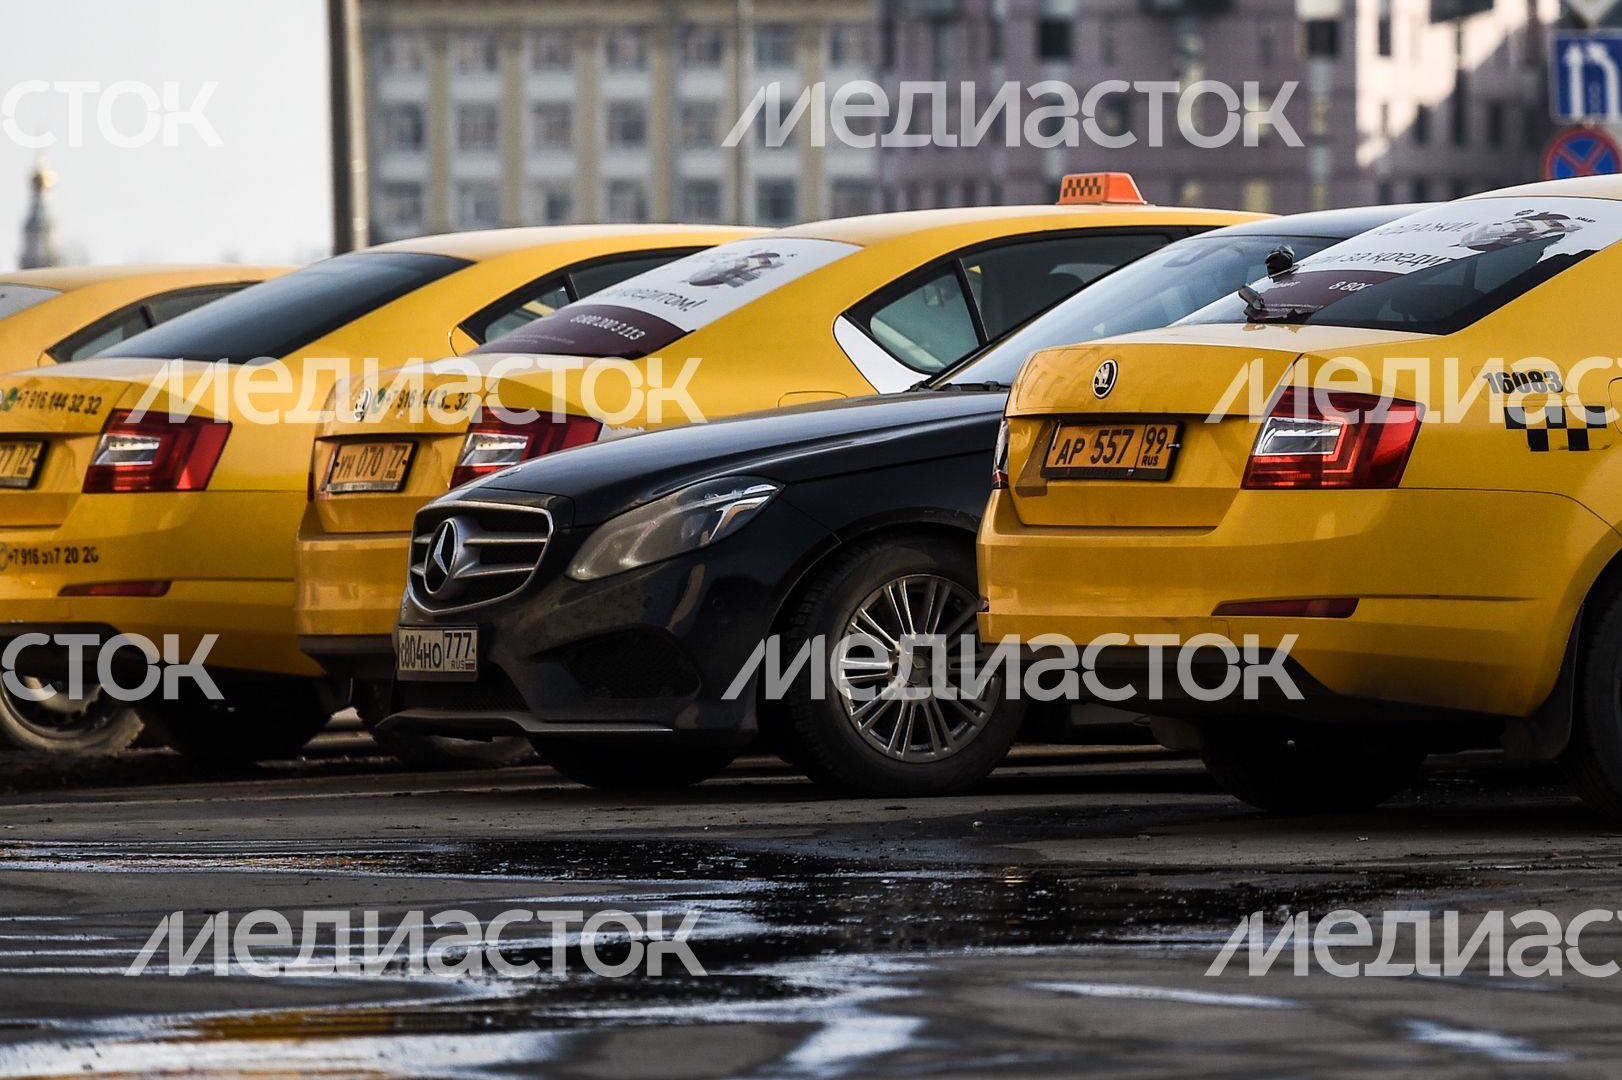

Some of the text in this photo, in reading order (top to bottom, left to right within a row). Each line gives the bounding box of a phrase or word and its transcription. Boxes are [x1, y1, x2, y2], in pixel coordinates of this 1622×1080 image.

[1482, 371, 1563, 394] 16083
[67, 393, 85, 413] 32
[84, 395, 102, 415] 32
[1090, 428, 1134, 465] 557
[1144, 427, 1168, 455] 99
[355, 446, 384, 478] 070
[389, 445, 408, 469] 77
[1141, 455, 1159, 467] RUS
[21, 548, 39, 565] 916
[64, 547, 79, 564] 20
[445, 632, 472, 659] 777
[450, 660, 465, 670] RUS
